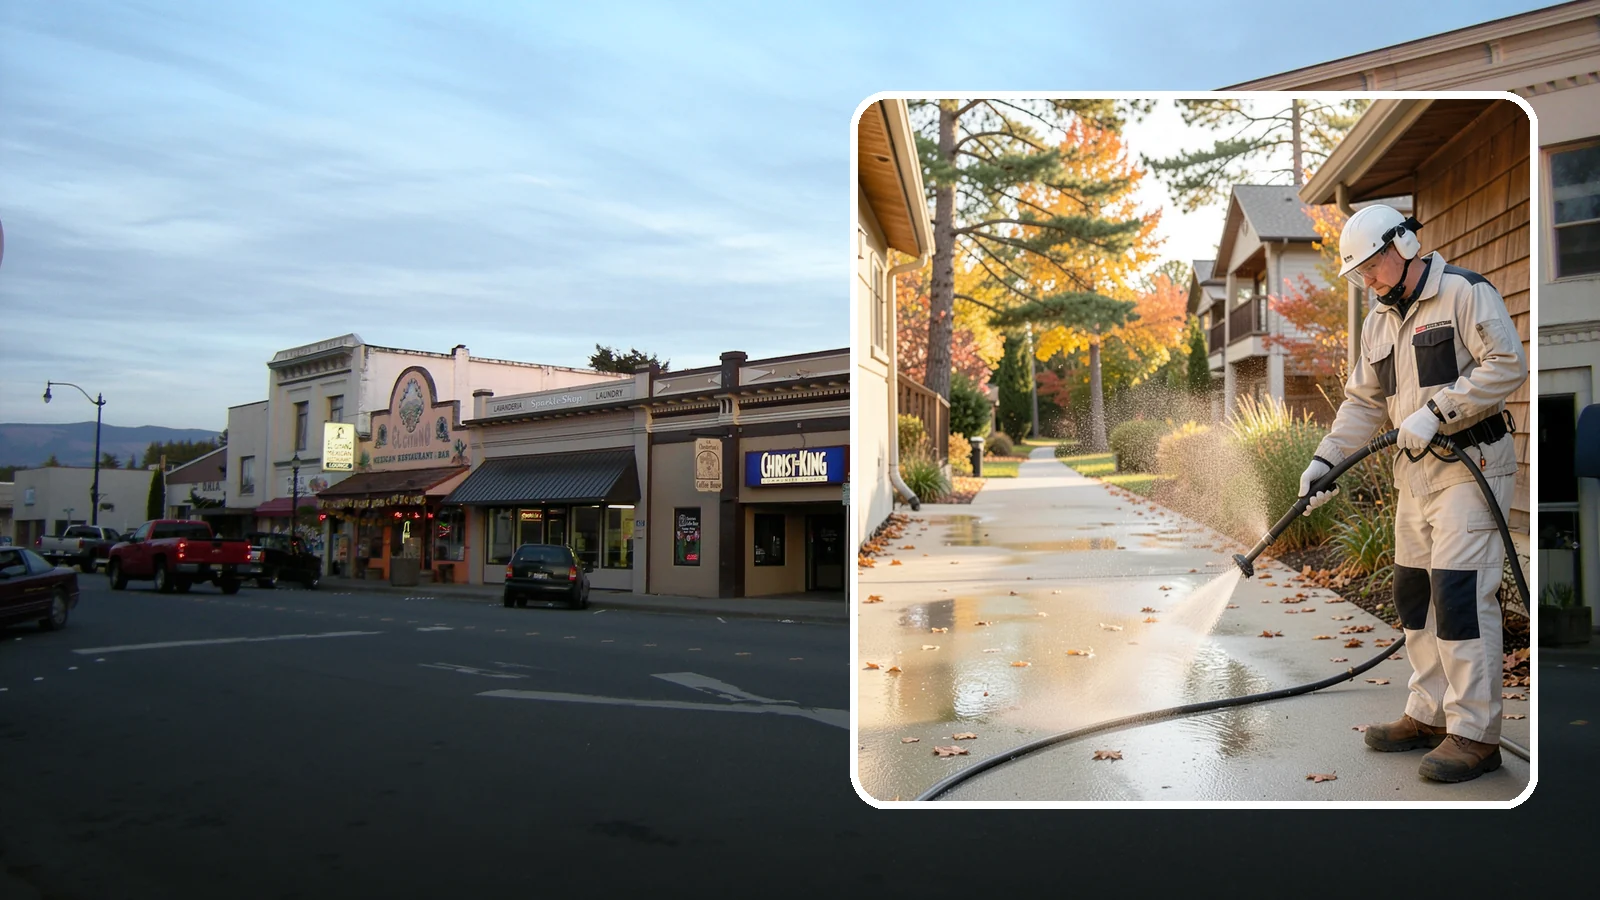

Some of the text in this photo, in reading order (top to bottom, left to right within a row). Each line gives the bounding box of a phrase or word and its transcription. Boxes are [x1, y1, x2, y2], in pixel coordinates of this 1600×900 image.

[494, 389, 624, 413] LAVANDERIA Sparkle Shop LAUNDRY
[392, 425, 401, 449] EL
[374, 455, 396, 464] MEXICAN
[398, 452, 433, 462] RESTAURANT
[438, 450, 450, 459] BAR
[761, 450, 827, 478] CHRIST KING
